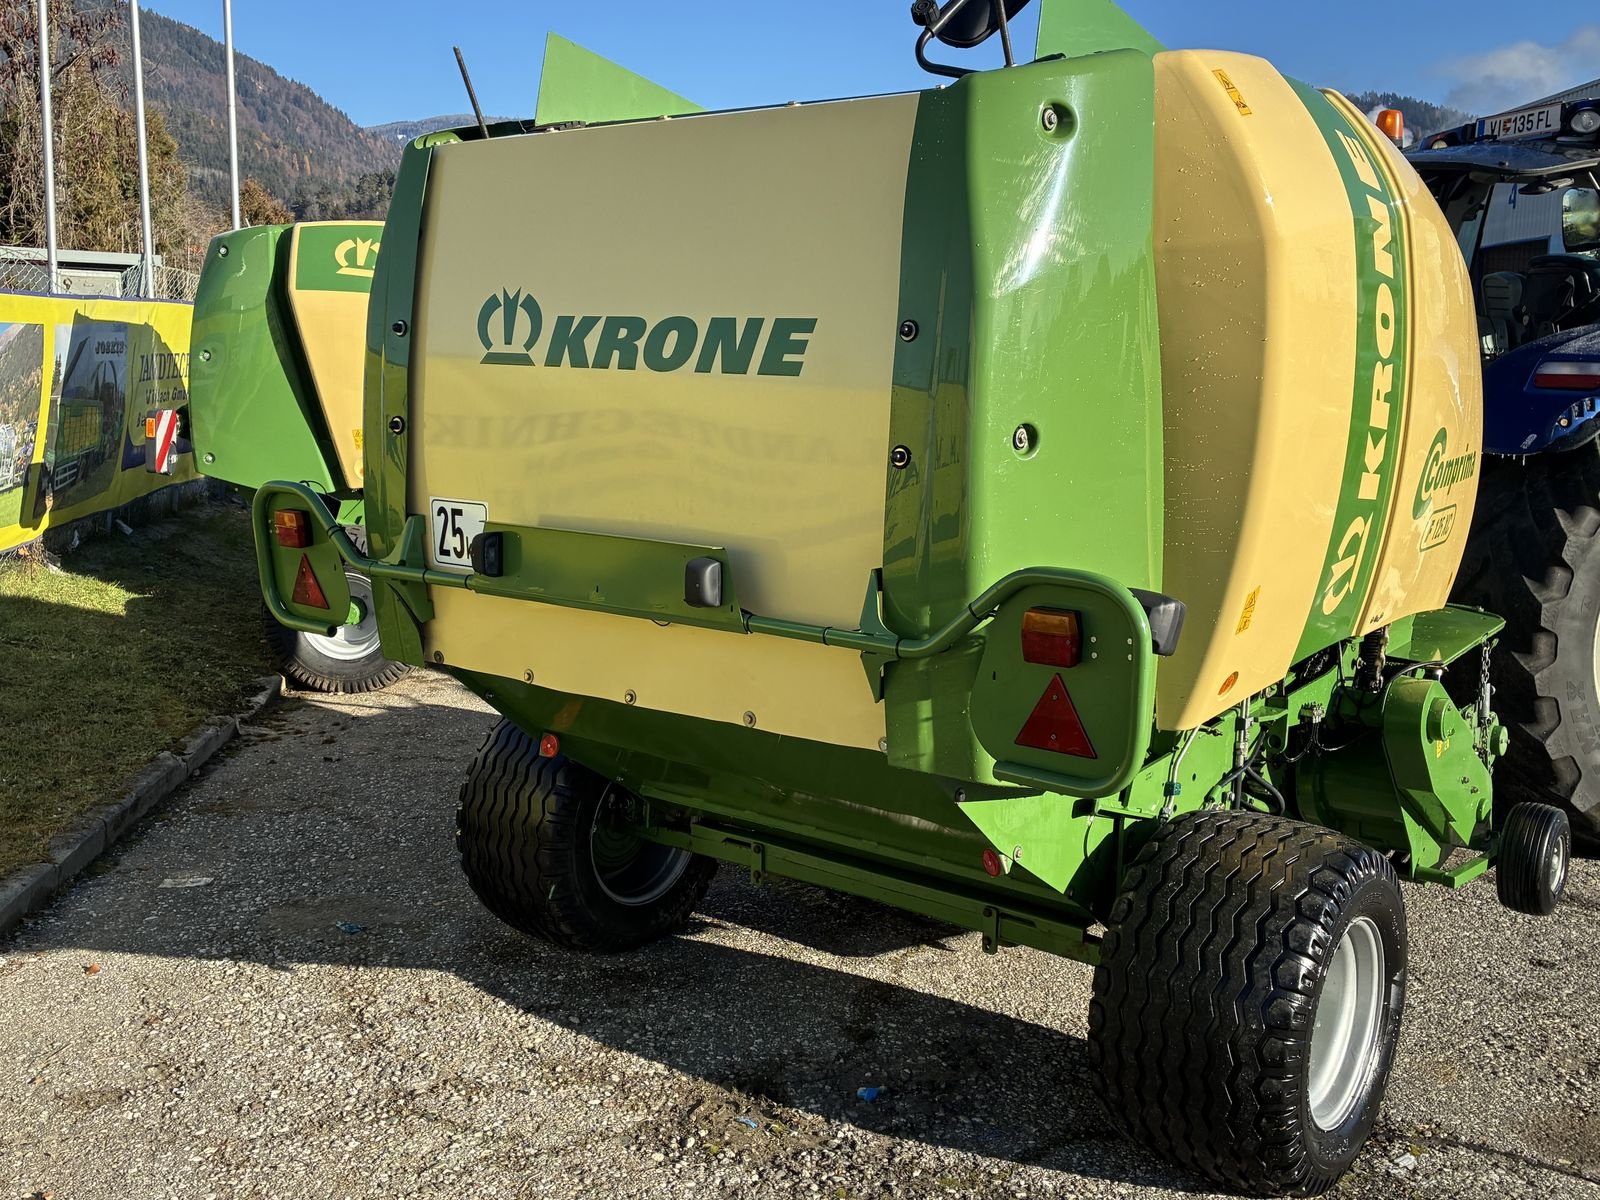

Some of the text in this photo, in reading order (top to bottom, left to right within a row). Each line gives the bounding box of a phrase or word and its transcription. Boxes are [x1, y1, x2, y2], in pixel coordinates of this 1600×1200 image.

[1512, 113, 1535, 133] 135
[1537, 109, 1552, 130] FL
[1508, 183, 1518, 209] 4
[1334, 128, 1395, 501] KRONE
[543, 315, 818, 377] KRONE
[436, 505, 465, 559] 25
